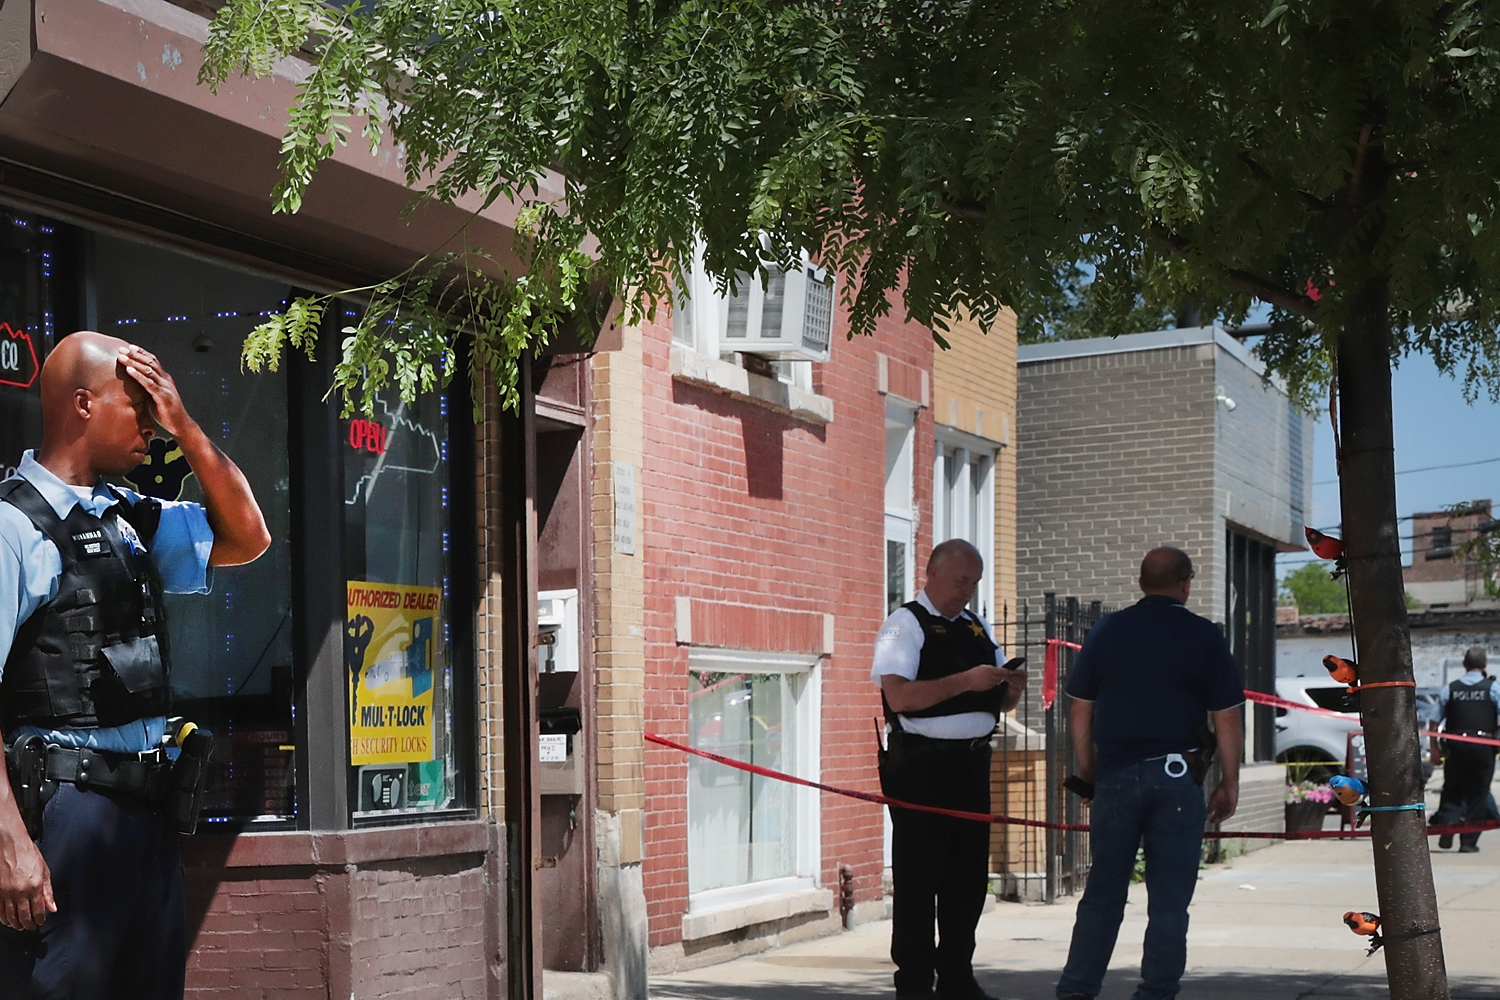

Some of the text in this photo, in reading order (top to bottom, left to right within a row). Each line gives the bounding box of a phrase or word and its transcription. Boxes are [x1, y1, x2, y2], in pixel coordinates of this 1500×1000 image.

[350, 419, 387, 454] OPEN
[347, 588, 439, 610] UTHORIZED DEALER
[1452, 690, 1486, 701] POLICE
[361, 737, 397, 754] SECURITY
[401, 736, 427, 753] LOCKS
